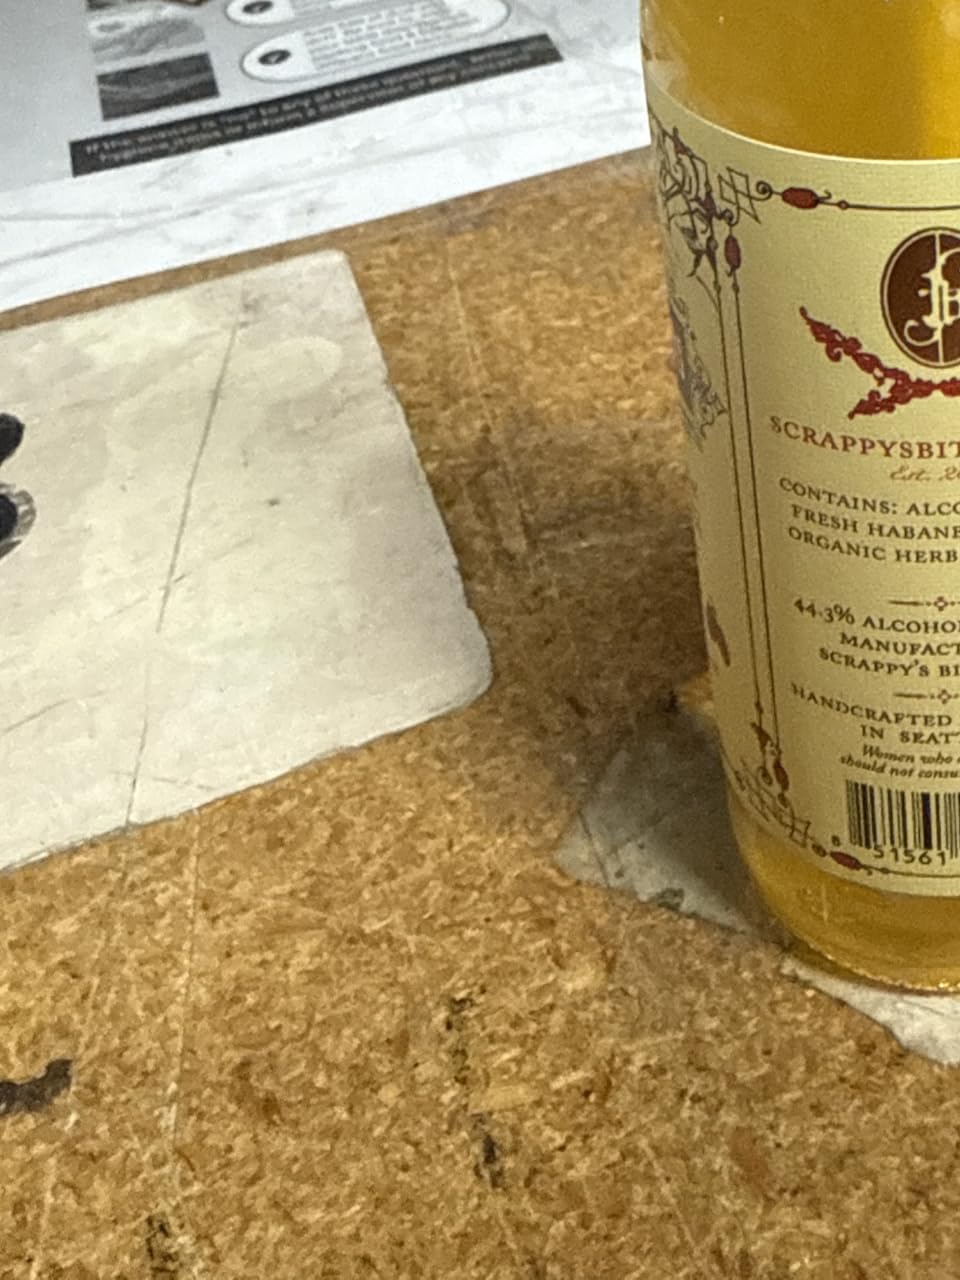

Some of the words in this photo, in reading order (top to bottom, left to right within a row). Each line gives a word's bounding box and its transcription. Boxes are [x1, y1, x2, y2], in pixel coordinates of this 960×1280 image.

[889, 462, 931, 482] Est.
[779, 476, 899, 516] CONTAINS:
[790, 503, 859, 534] FRESH
[788, 526, 887, 562] ORGANIC
[793, 598, 856, 626] 44.3%
[819, 646, 930, 679] SCRAPPY'S
[791, 683, 953, 727] HANDCRAFTED
[860, 724, 885, 741] IN
[839, 755, 887, 777] should
[890, 766, 913, 778] not
[861, 743, 916, 764] Women
[920, 752, 953, 765] who
[873, 842, 948, 867] 51561
